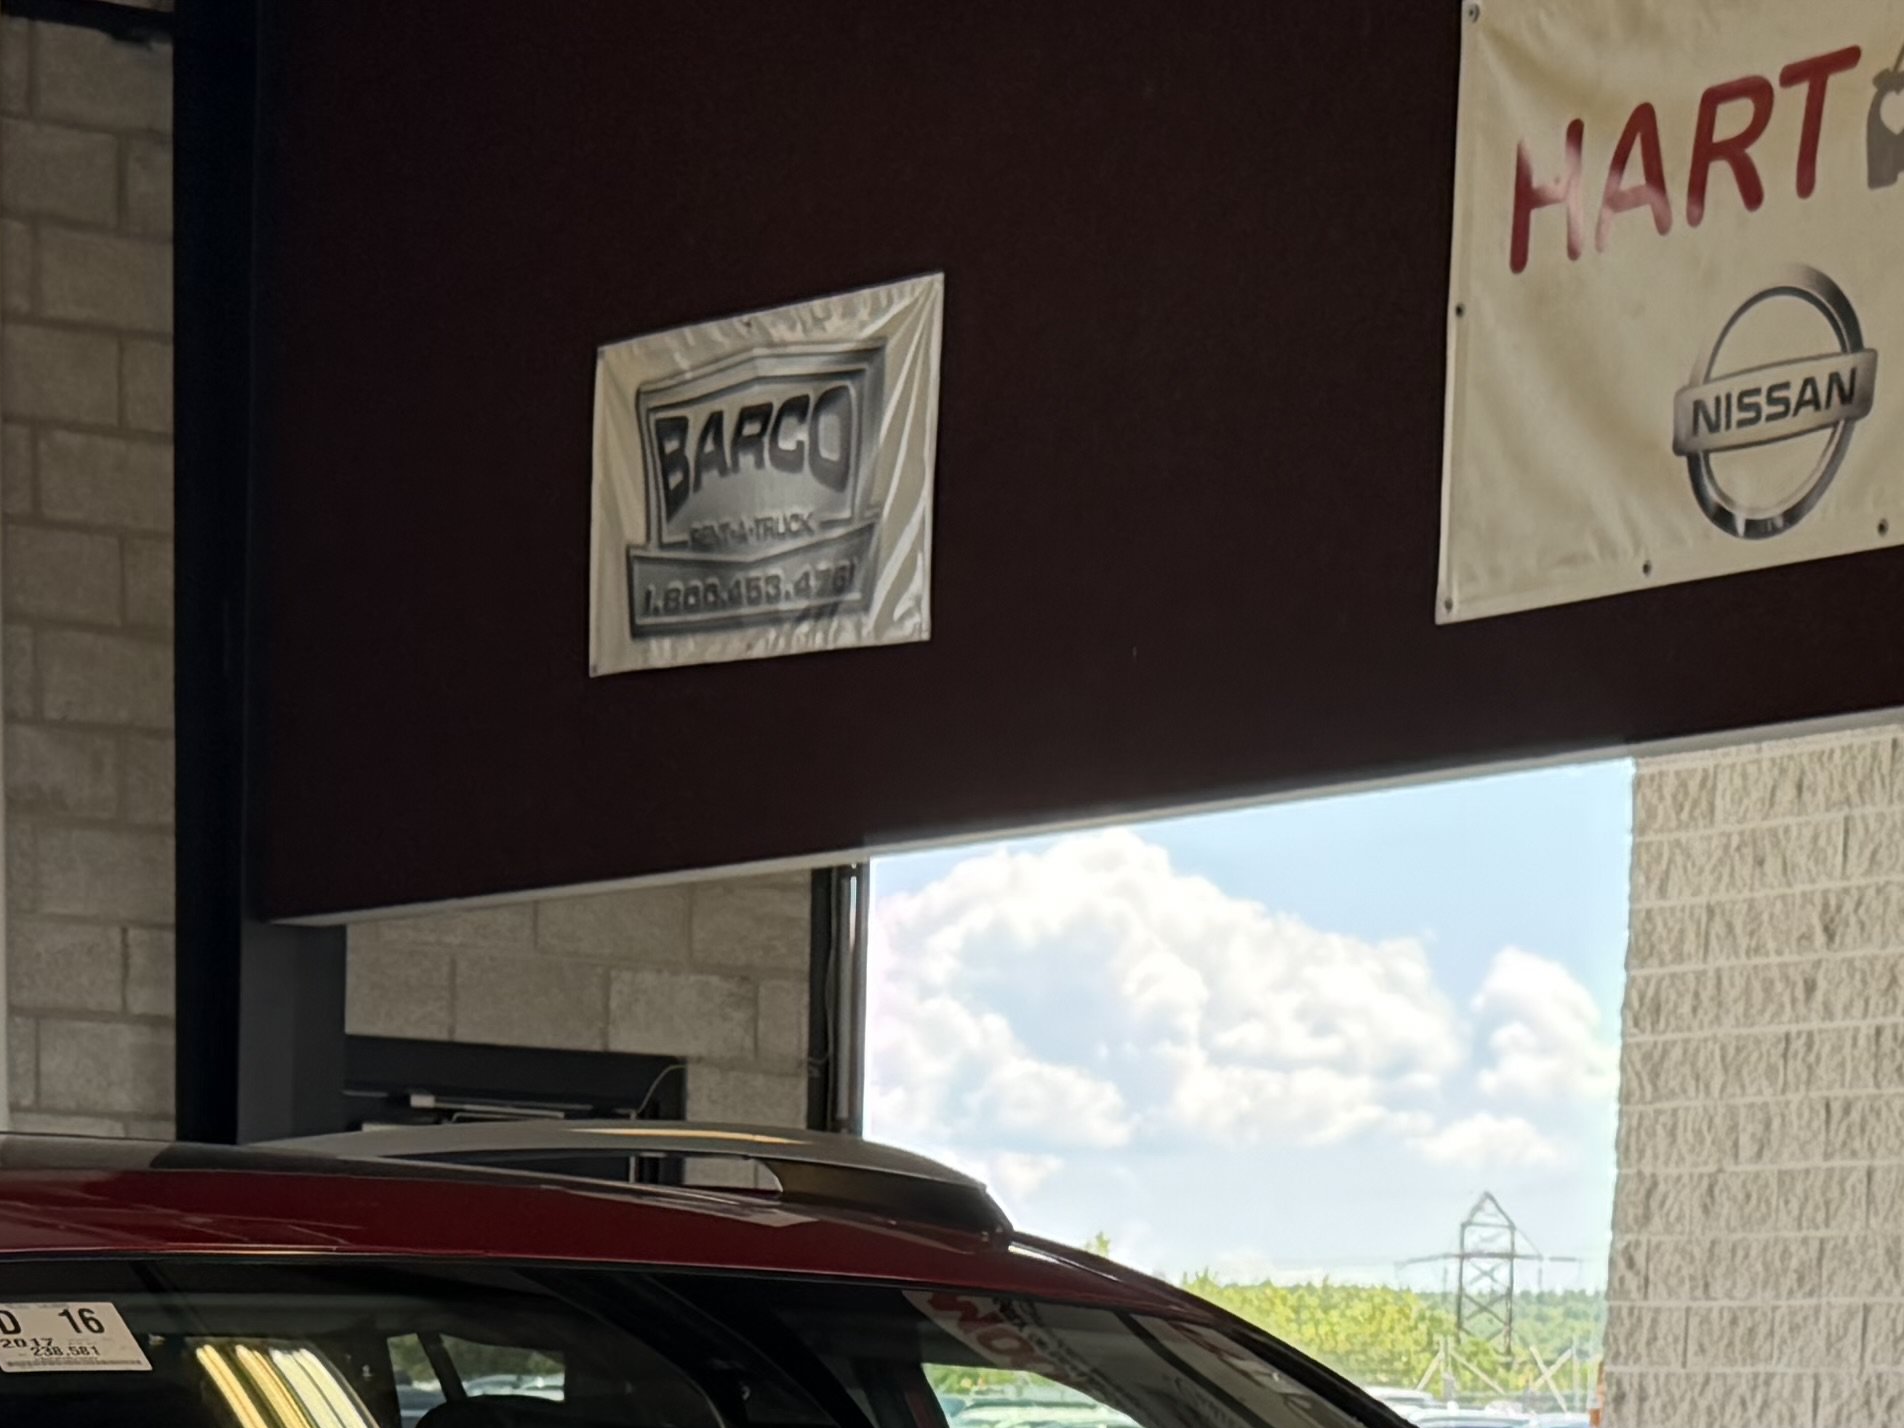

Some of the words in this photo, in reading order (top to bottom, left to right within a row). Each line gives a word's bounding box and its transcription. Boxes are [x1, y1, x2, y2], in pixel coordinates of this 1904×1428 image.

[1508, 45, 1864, 276] HART
[654, 384, 854, 522] BARCO
[1688, 364, 1860, 437] NISSAN
[58, 1307, 106, 1335] 16
